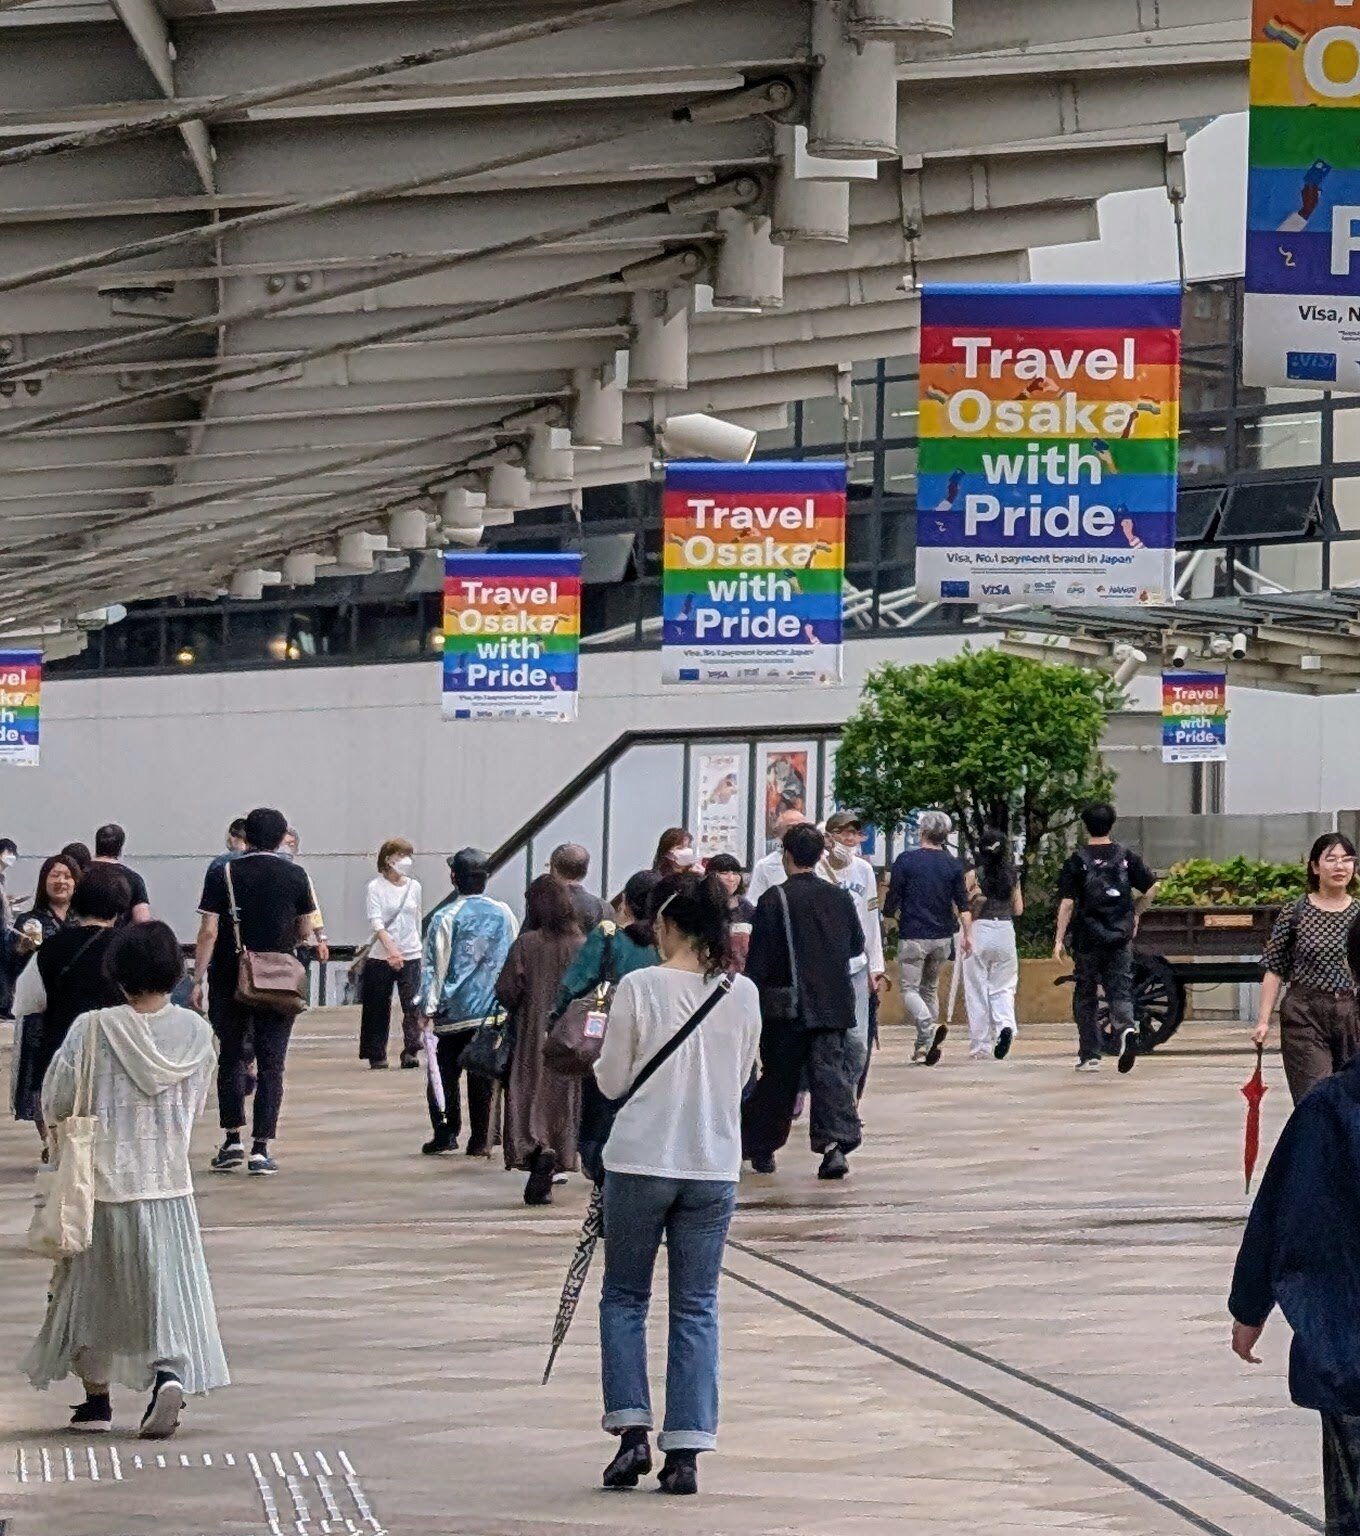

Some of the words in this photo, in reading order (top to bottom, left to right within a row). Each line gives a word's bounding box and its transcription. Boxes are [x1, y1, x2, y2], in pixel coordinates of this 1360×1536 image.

[1299, 306, 1342, 324] Visa,
[952, 337, 1135, 380] Travel
[948, 389, 1135, 434] Osaka
[982, 443, 1102, 485] with
[687, 499, 815, 530] Travel
[965, 495, 1115, 538] Pride
[684, 535, 813, 568] Osaka
[461, 581, 558, 605] Travel
[708, 572, 792, 602] with
[981, 584, 1011, 595] VISA
[458, 609, 557, 633] Osaka
[696, 608, 801, 639] Pride
[476, 636, 540, 660] with
[468, 663, 547, 687] Pride
[1172, 686, 1219, 699] Travel
[1180, 716, 1211, 729] with
[1175, 730, 1214, 743] Pride
